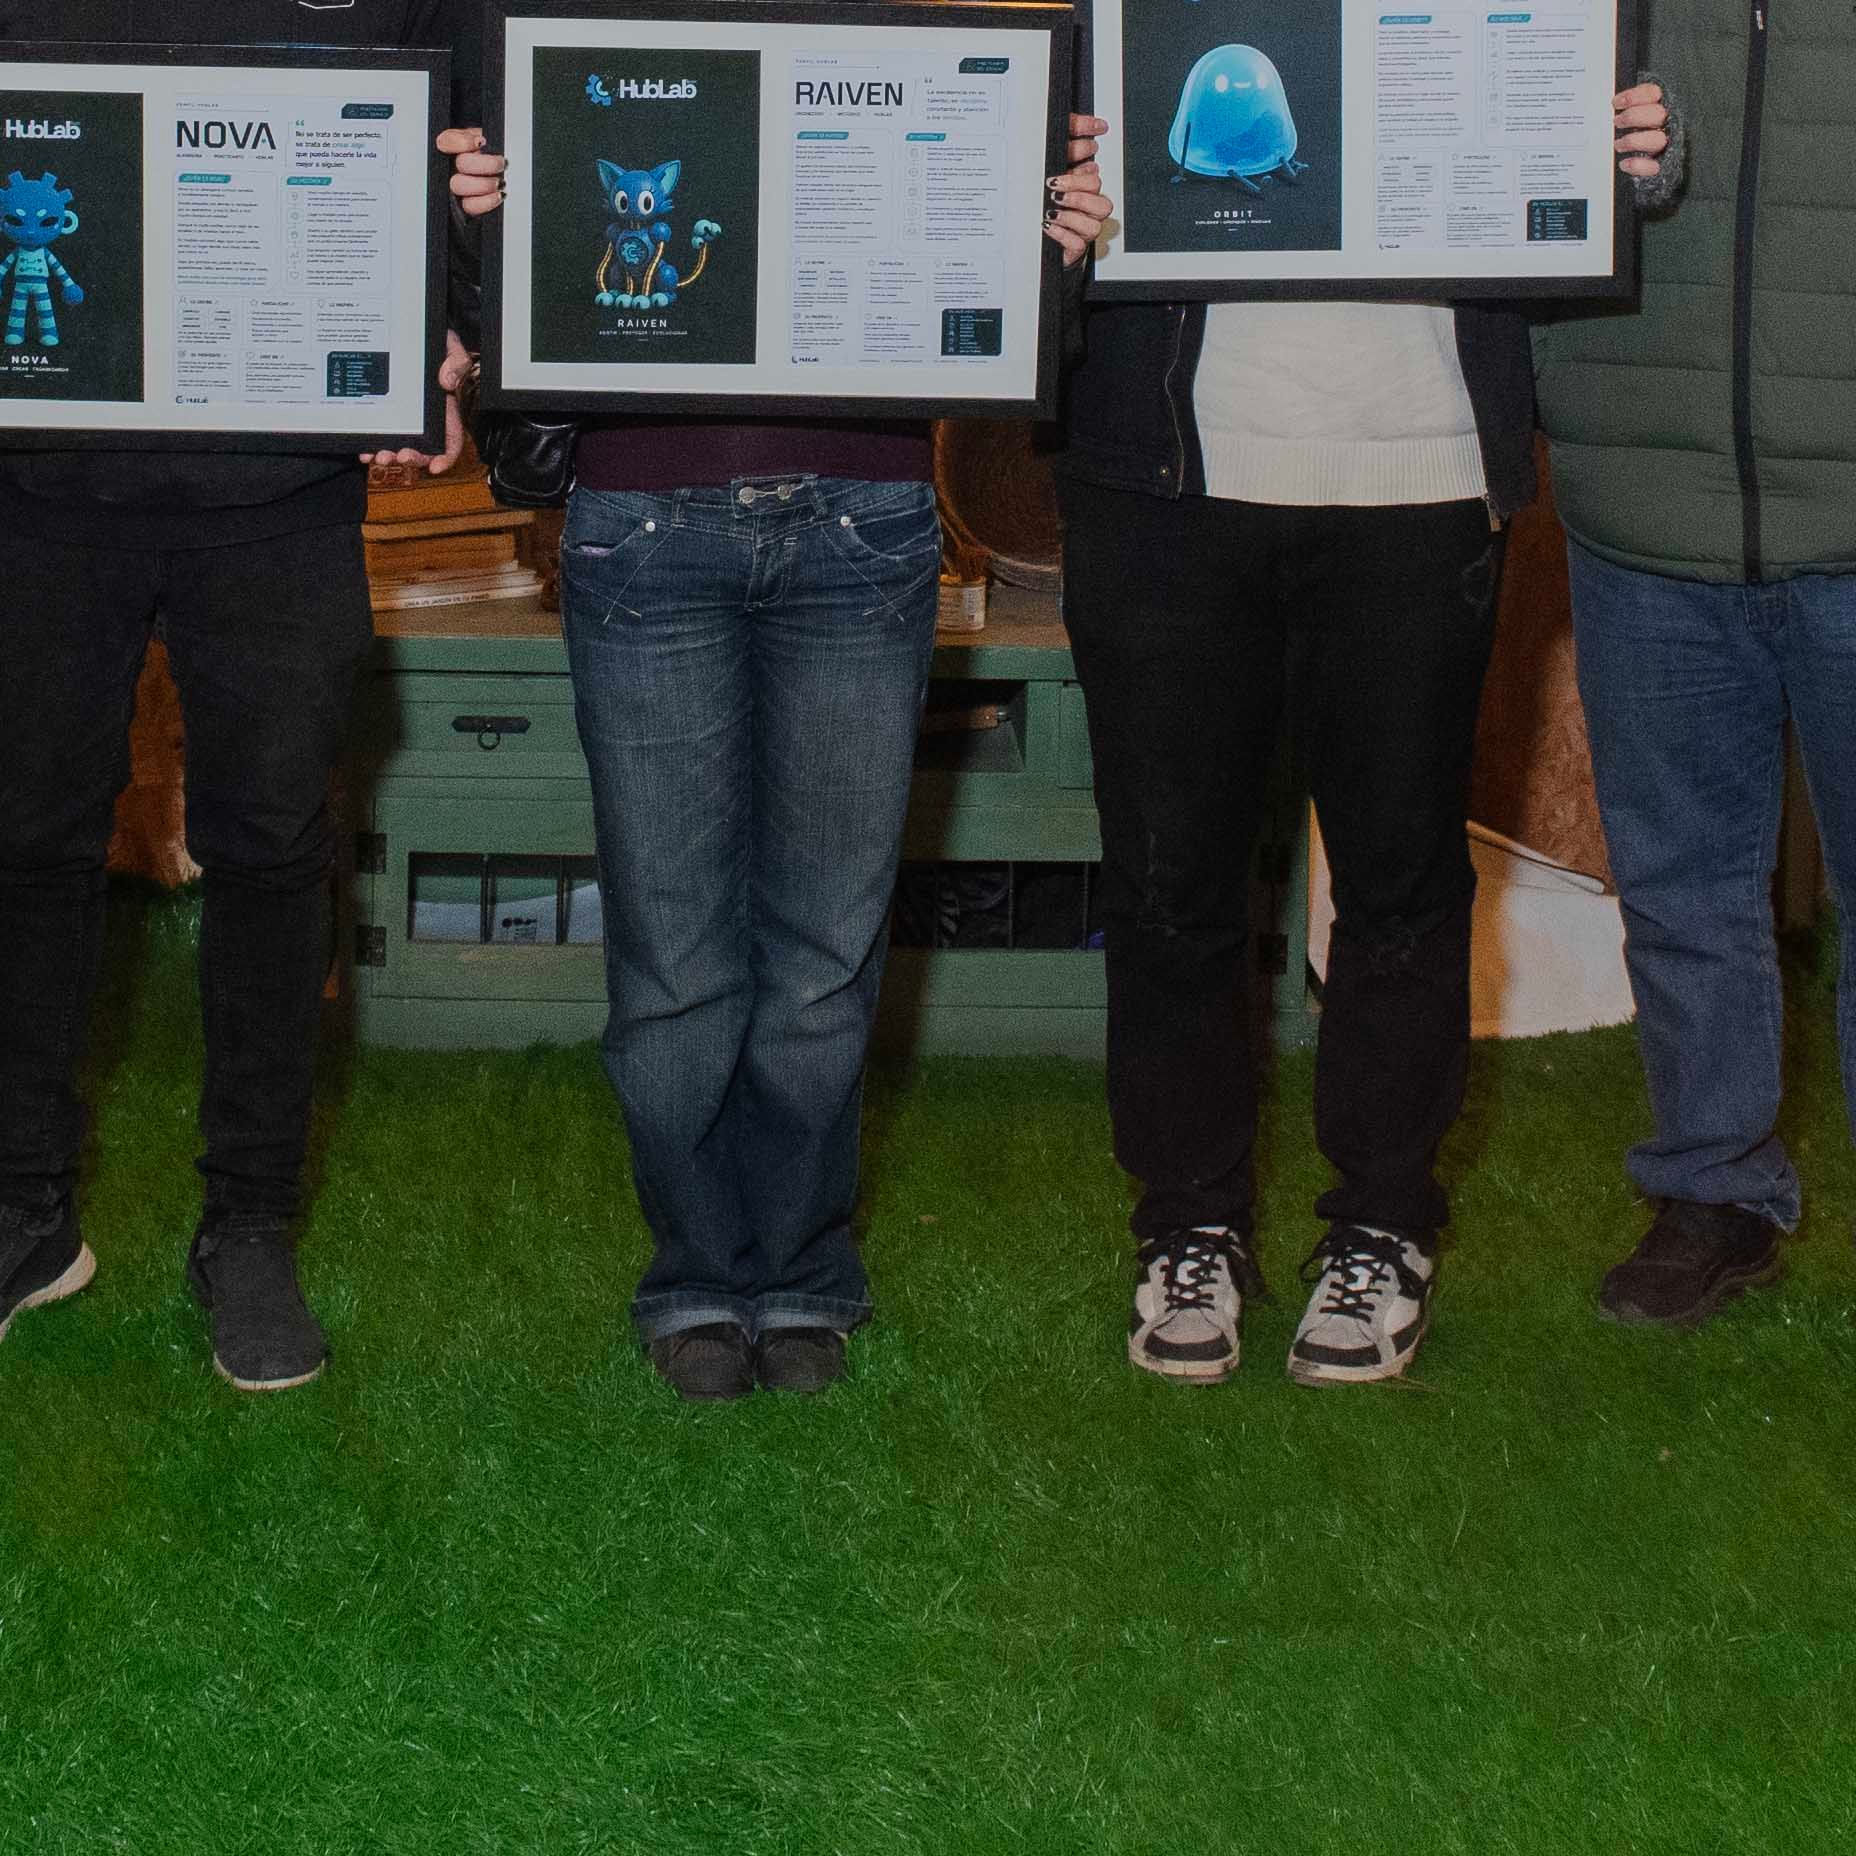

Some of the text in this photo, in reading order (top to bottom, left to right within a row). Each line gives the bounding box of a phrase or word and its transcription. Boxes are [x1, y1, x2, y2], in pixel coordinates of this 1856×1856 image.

[619, 79, 697, 98] HubLab
[795, 81, 903, 106] RAIVEN
[6, 119, 81, 139] HubLab
[176, 120, 276, 149] NOVA
[1214, 210, 1252, 218] ORBIT
[617, 319, 667, 328] RAIVEN
[11, 355, 49, 364] NOVA
